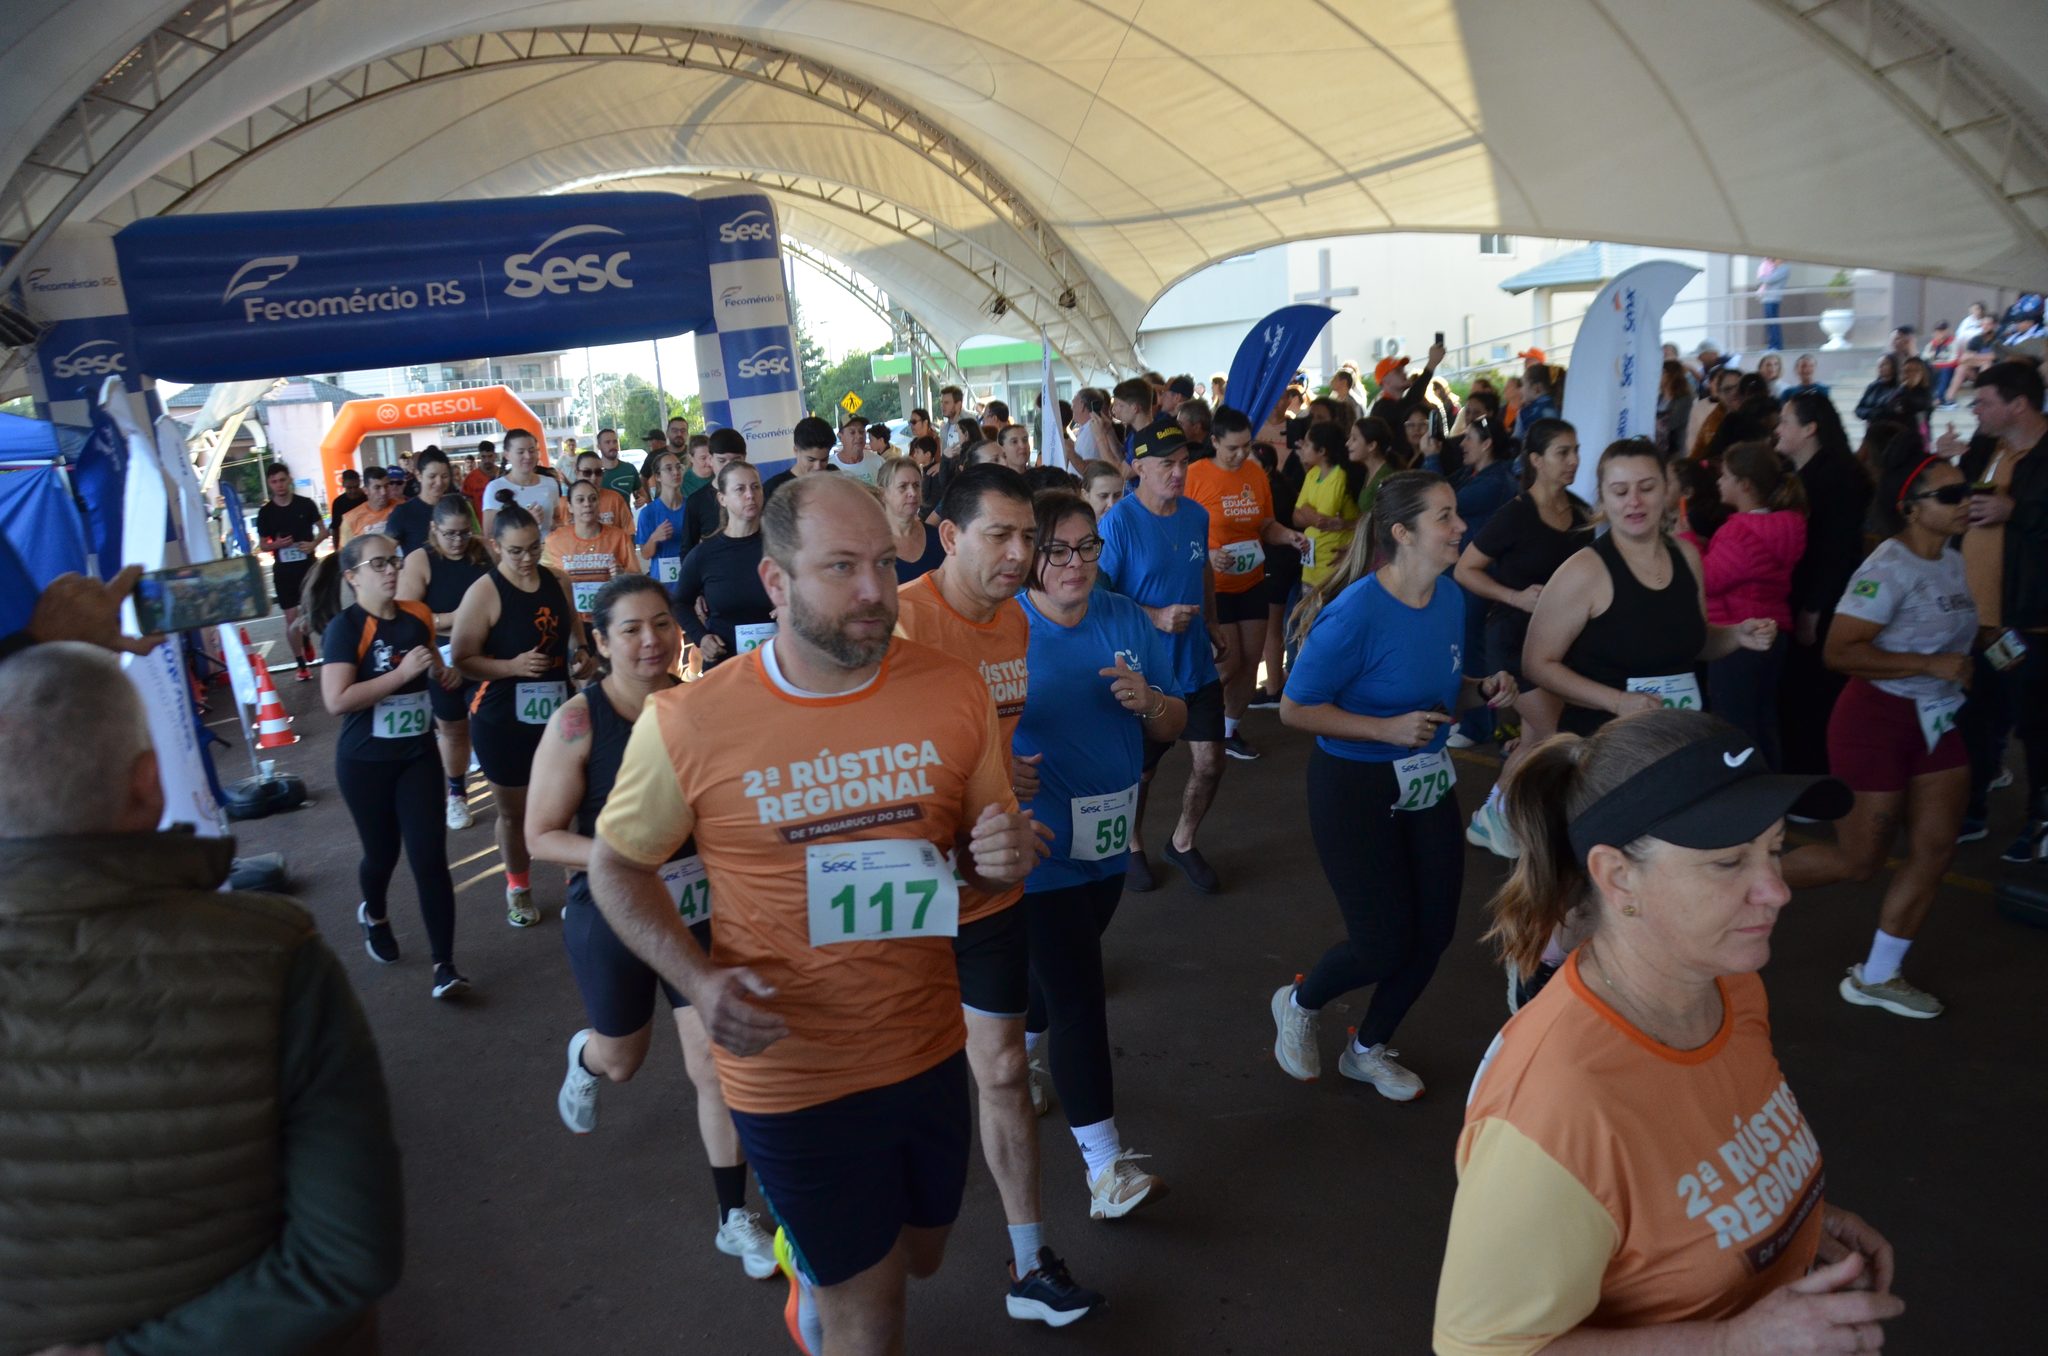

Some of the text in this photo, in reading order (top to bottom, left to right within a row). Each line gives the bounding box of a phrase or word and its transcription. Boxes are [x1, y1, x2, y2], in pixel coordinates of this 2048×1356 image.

[31, 278, 100, 292] Fecomércio
[504, 250, 633, 298] Sesc
[244, 280, 466, 323] Fecomércio RS
[725, 294, 775, 307] Fecomércio
[53, 353, 128, 378] Sesc
[738, 356, 791, 378] Sesc
[405, 396, 484, 421] CRESOL
[1236, 553, 1256, 572] 87
[577, 593, 596, 610] 28
[383, 707, 426, 735] 129
[742, 740, 943, 797] 2ª RÚSTICA
[757, 769, 935, 825] REGIONAL
[1404, 769, 1449, 808] 279
[790, 829, 805, 840] DE
[877, 811, 894, 822] DO
[896, 807, 915, 818] SUL
[1095, 814, 1127, 854] 59
[680, 877, 710, 919] 47
[829, 878, 938, 936] 117
[1677, 1078, 1799, 1220] 2ª RÚSTIC
